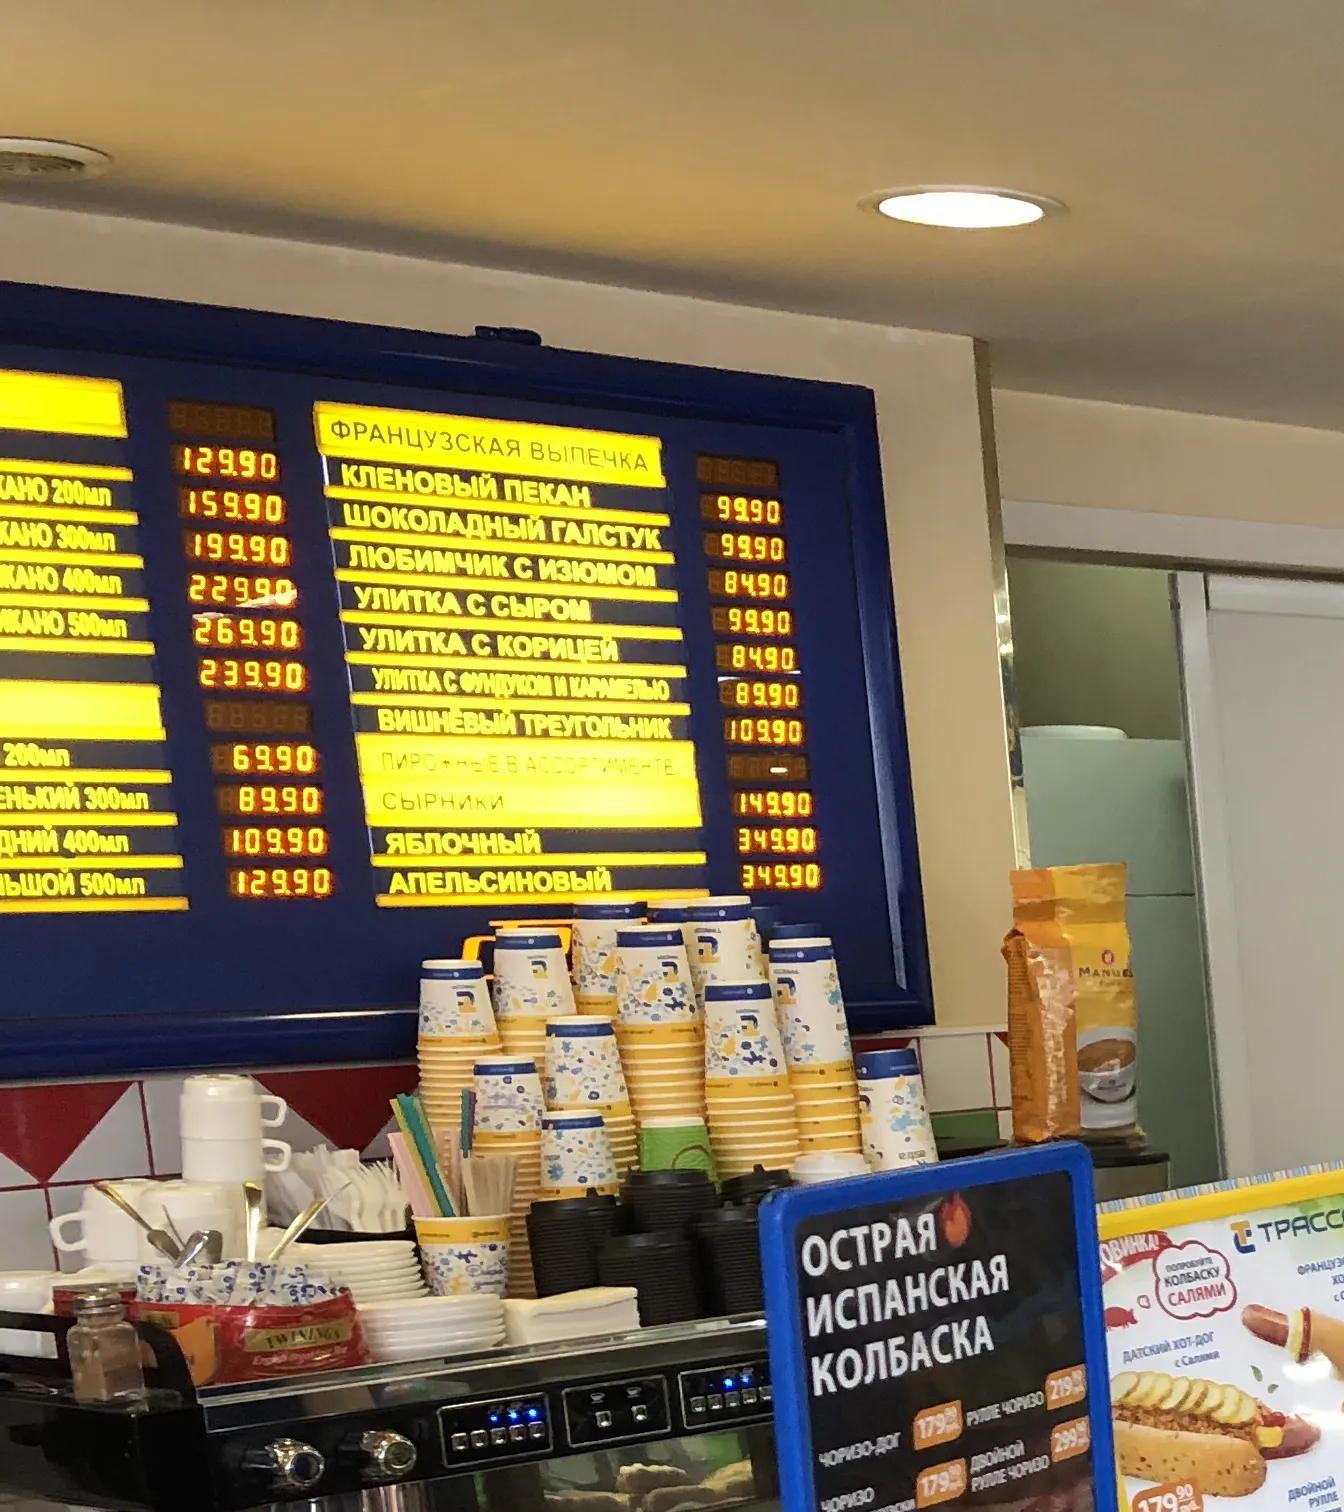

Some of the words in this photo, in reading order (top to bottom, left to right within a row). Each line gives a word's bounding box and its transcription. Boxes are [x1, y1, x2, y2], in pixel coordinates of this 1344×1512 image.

[331, 419, 521, 459] ФРАНЦУЗСКАЯ
[530, 440, 649, 473] ВЫПЕЧКА
[183, 446, 277, 479] 129.90
[51, 479, 112, 507] 200мл
[341, 463, 497, 500] КЛЕНОВЫЙ
[504, 480, 591, 509] ПЕКАН
[188, 490, 282, 523] 159.90
[717, 495, 781, 523] 99.90
[55, 525, 116, 552] 300мл
[342, 502, 546, 542] ШОКОЛАДНЫЙ
[552, 520, 662, 550] ГАЛСТУК
[194, 533, 287, 565] 199.90
[721, 532, 784, 561] 99.90
[348, 543, 508, 578] ЛЮБИМЧИК
[513, 557, 534, 579] С
[539, 559, 656, 588] ИЗЮМОМ
[62, 569, 122, 595] 400мл
[724, 569, 786, 597] 84.90
[354, 586, 463, 615] УЛИТКА
[466, 594, 486, 616] С
[492, 596, 592, 623] СЫРОМ
[68, 614, 128, 639] 500мл
[194, 618, 298, 648] 269.90
[728, 607, 791, 635] 99.90
[360, 627, 467, 656] УЛИТКА
[471, 635, 491, 657] С
[496, 635, 619, 664] КОРИЦЕЙ
[732, 647, 795, 672] 84.90
[200, 659, 303, 690] 239.90
[372, 668, 443, 692] УЛИТКА
[736, 682, 798, 708] 89.90
[522, 712, 672, 741] ТРЕУГОЛЬНИК
[728, 717, 803, 744] 109.90
[232, 745, 315, 772] 69.90
[85, 787, 149, 811] 300мл
[239, 787, 321, 814] 89.90
[382, 791, 505, 812] СЫРНИКИ
[739, 792, 812, 818] 149.90
[63, 829, 129, 853] 400мл
[232, 828, 325, 854] 109.90
[386, 828, 543, 855] ЯБЛОЧНЫЙ
[738, 828, 816, 854] 349.90
[80, 871, 146, 896] 500мл
[237, 869, 331, 895] 129.90
[389, 866, 613, 895] АПЕЛЬСИНОВЫЙ
[742, 864, 819, 889] 349.90
[802, 1213, 937, 1276] ОСТРАЯ
[1164, 1266, 1221, 1288] КОЛБАСКУ
[807, 1254, 1010, 1337] ИСПАНСКАЯ
[1168, 1284, 1226, 1307] САЛЯМИ
[811, 1315, 995, 1397] КОЛБАСКА
[1123, 1339, 1172, 1364] ДАТСКИЙ
[1173, 1331, 1215, 1352] ХОТ-ДОГ
[1288, 1475, 1337, 1502] ДВОЙНОЙ
[1308, 1489, 1339, 1507] РУЛЛЕ
